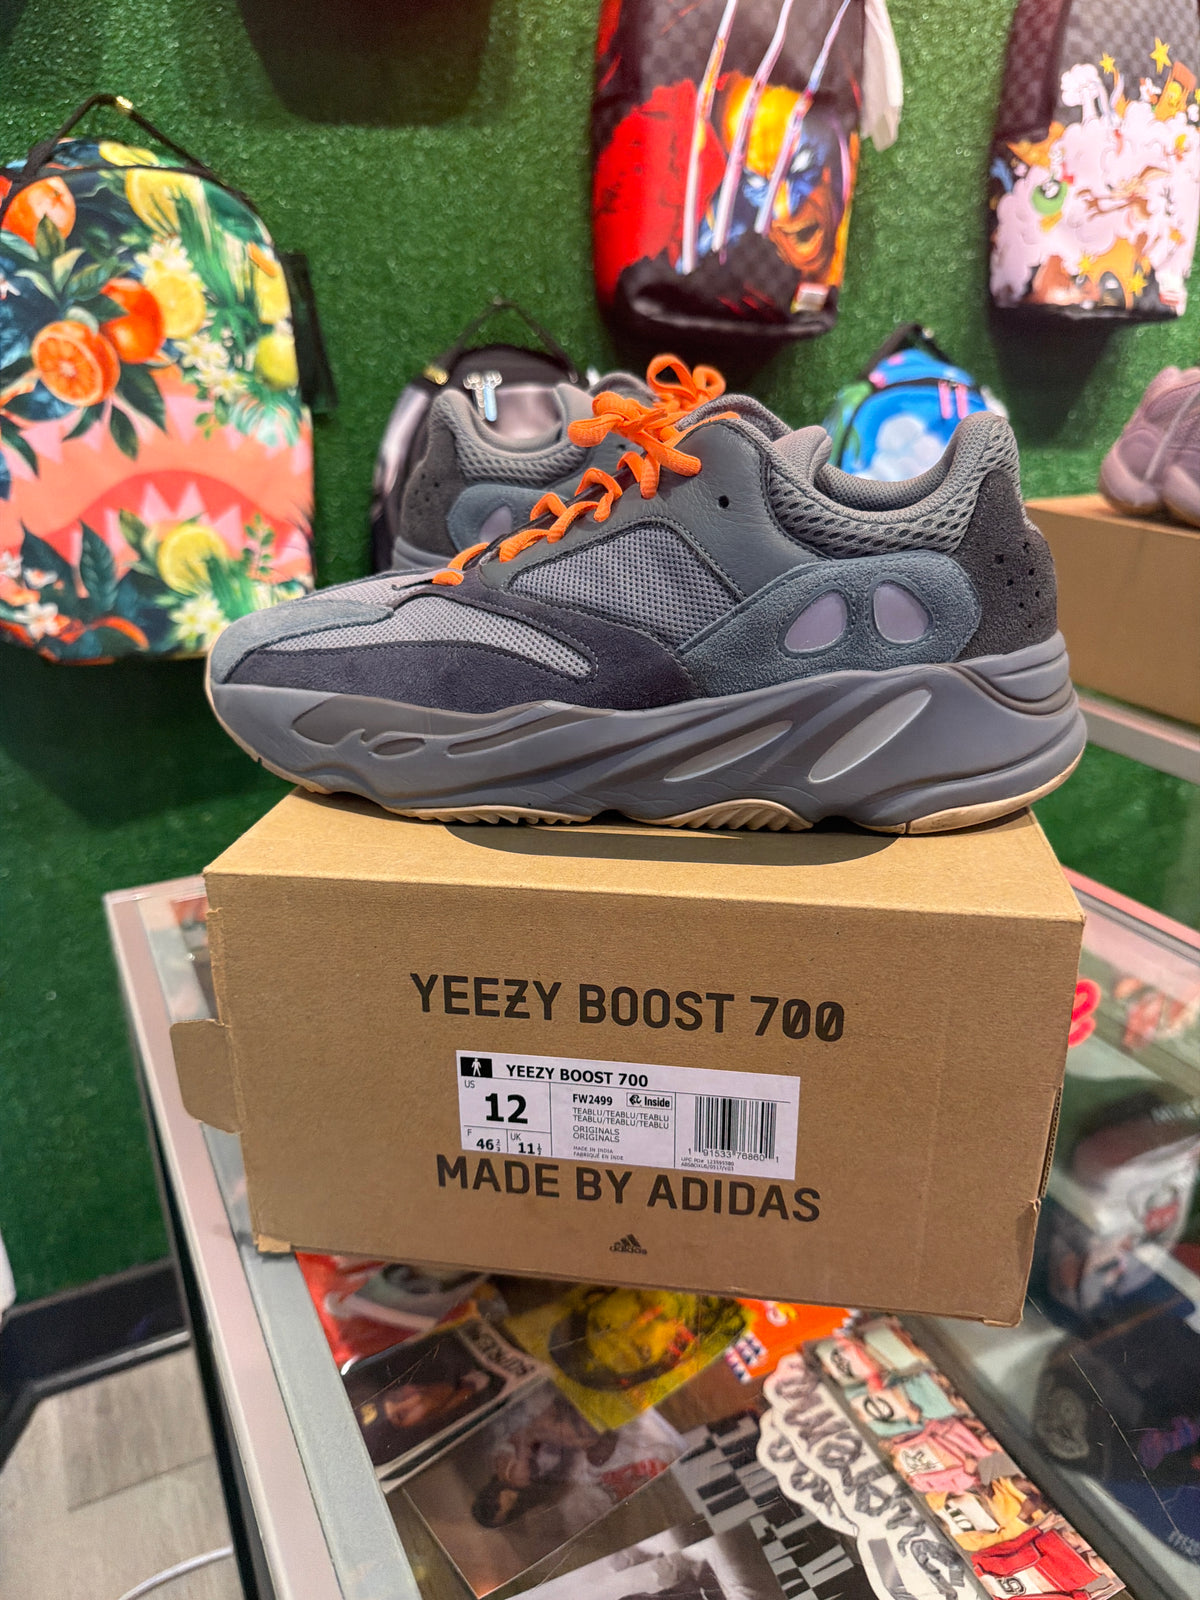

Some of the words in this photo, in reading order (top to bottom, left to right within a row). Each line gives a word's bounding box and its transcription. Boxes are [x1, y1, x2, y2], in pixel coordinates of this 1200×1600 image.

[410, 972, 562, 1020] YEEZY
[579, 983, 735, 1034] BOOST
[749, 996, 846, 1043] 700
[506, 1064, 554, 1079] YEEZY
[560, 1068, 613, 1084] BOOST
[618, 1073, 649, 1087] 700
[464, 1080, 475, 1088] US
[485, 1092, 528, 1124] 12
[572, 1093, 613, 1106] FW2499
[643, 1095, 670, 1108] Inside
[573, 1107, 670, 1122] TEABLU/TEABLU/TEABLU
[573, 1114, 670, 1129] TEABLU/TEABLU/TEABLU
[467, 1128, 472, 1136] F
[510, 1132, 522, 1141] UK
[573, 1125, 620, 1135] ORIGINALS
[573, 1132, 620, 1143] ORIGINALS
[436, 1153, 560, 1199] MADE
[576, 1166, 635, 1204] BY
[646, 1173, 822, 1223] ADIDAS
